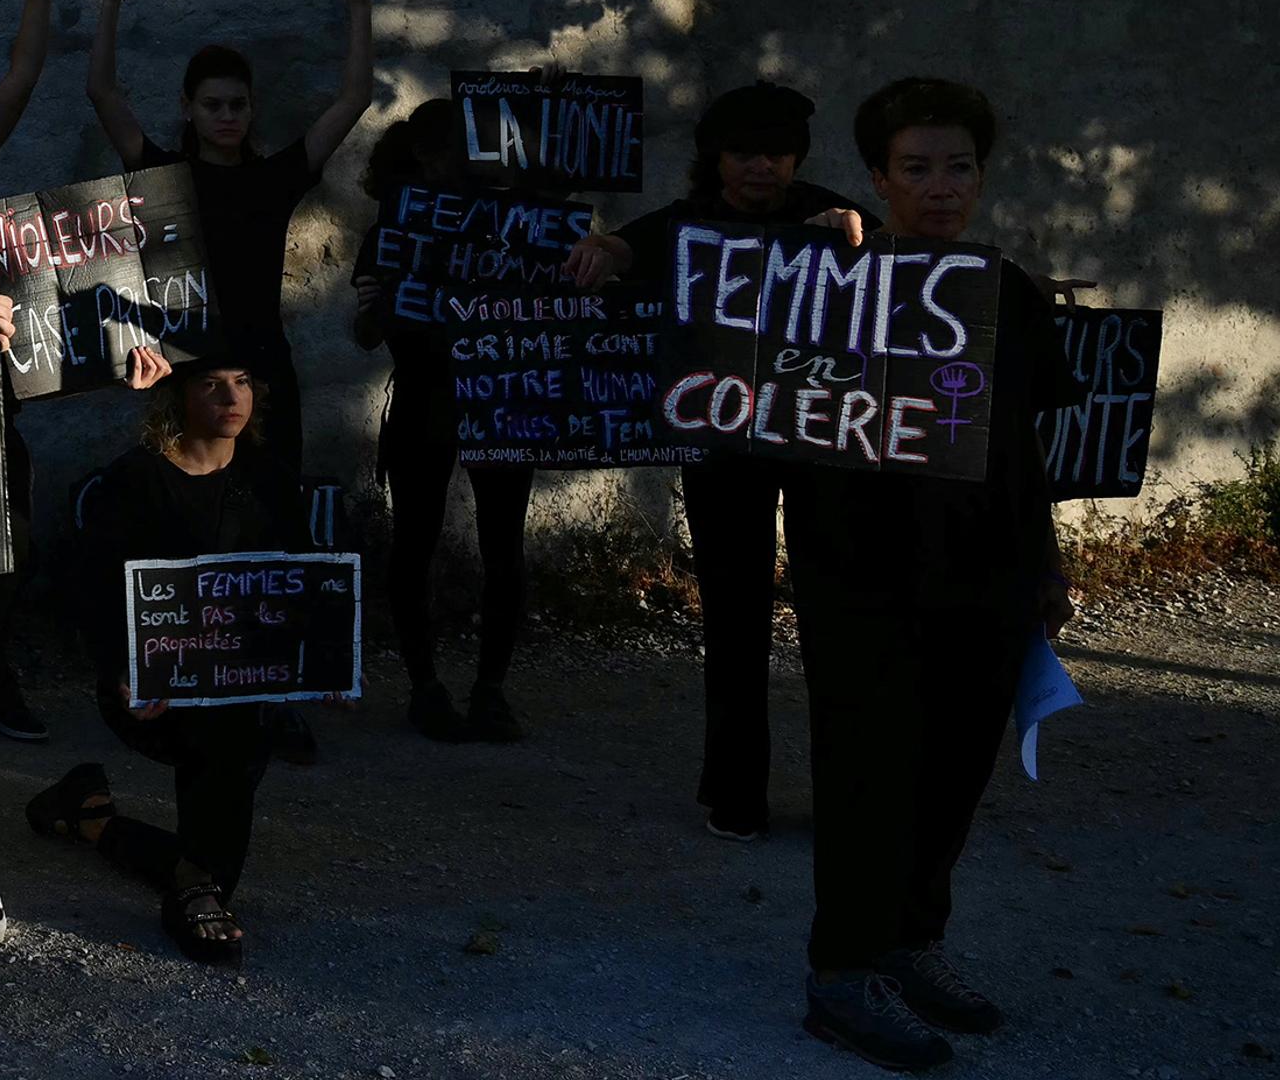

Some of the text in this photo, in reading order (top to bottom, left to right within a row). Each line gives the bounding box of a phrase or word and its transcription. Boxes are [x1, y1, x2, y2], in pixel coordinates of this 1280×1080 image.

[463, 97, 529, 169] LA
[397, 184, 592, 250] FEMMES
[376, 226, 434, 271] ET
[448, 293, 608, 321] VIOLEUR
[675, 225, 987, 359] FEMMES
[95, 270, 207, 359] PRISON
[451, 329, 573, 361] CRIME
[773, 347, 861, 383] en
[455, 370, 564, 401] NOTRE
[664, 372, 938, 463] COLÈRE
[138, 571, 176, 601] Les
[197, 569, 304, 599] FEMMES
[141, 602, 288, 627] sont PAS les
[169, 665, 198, 688] des
